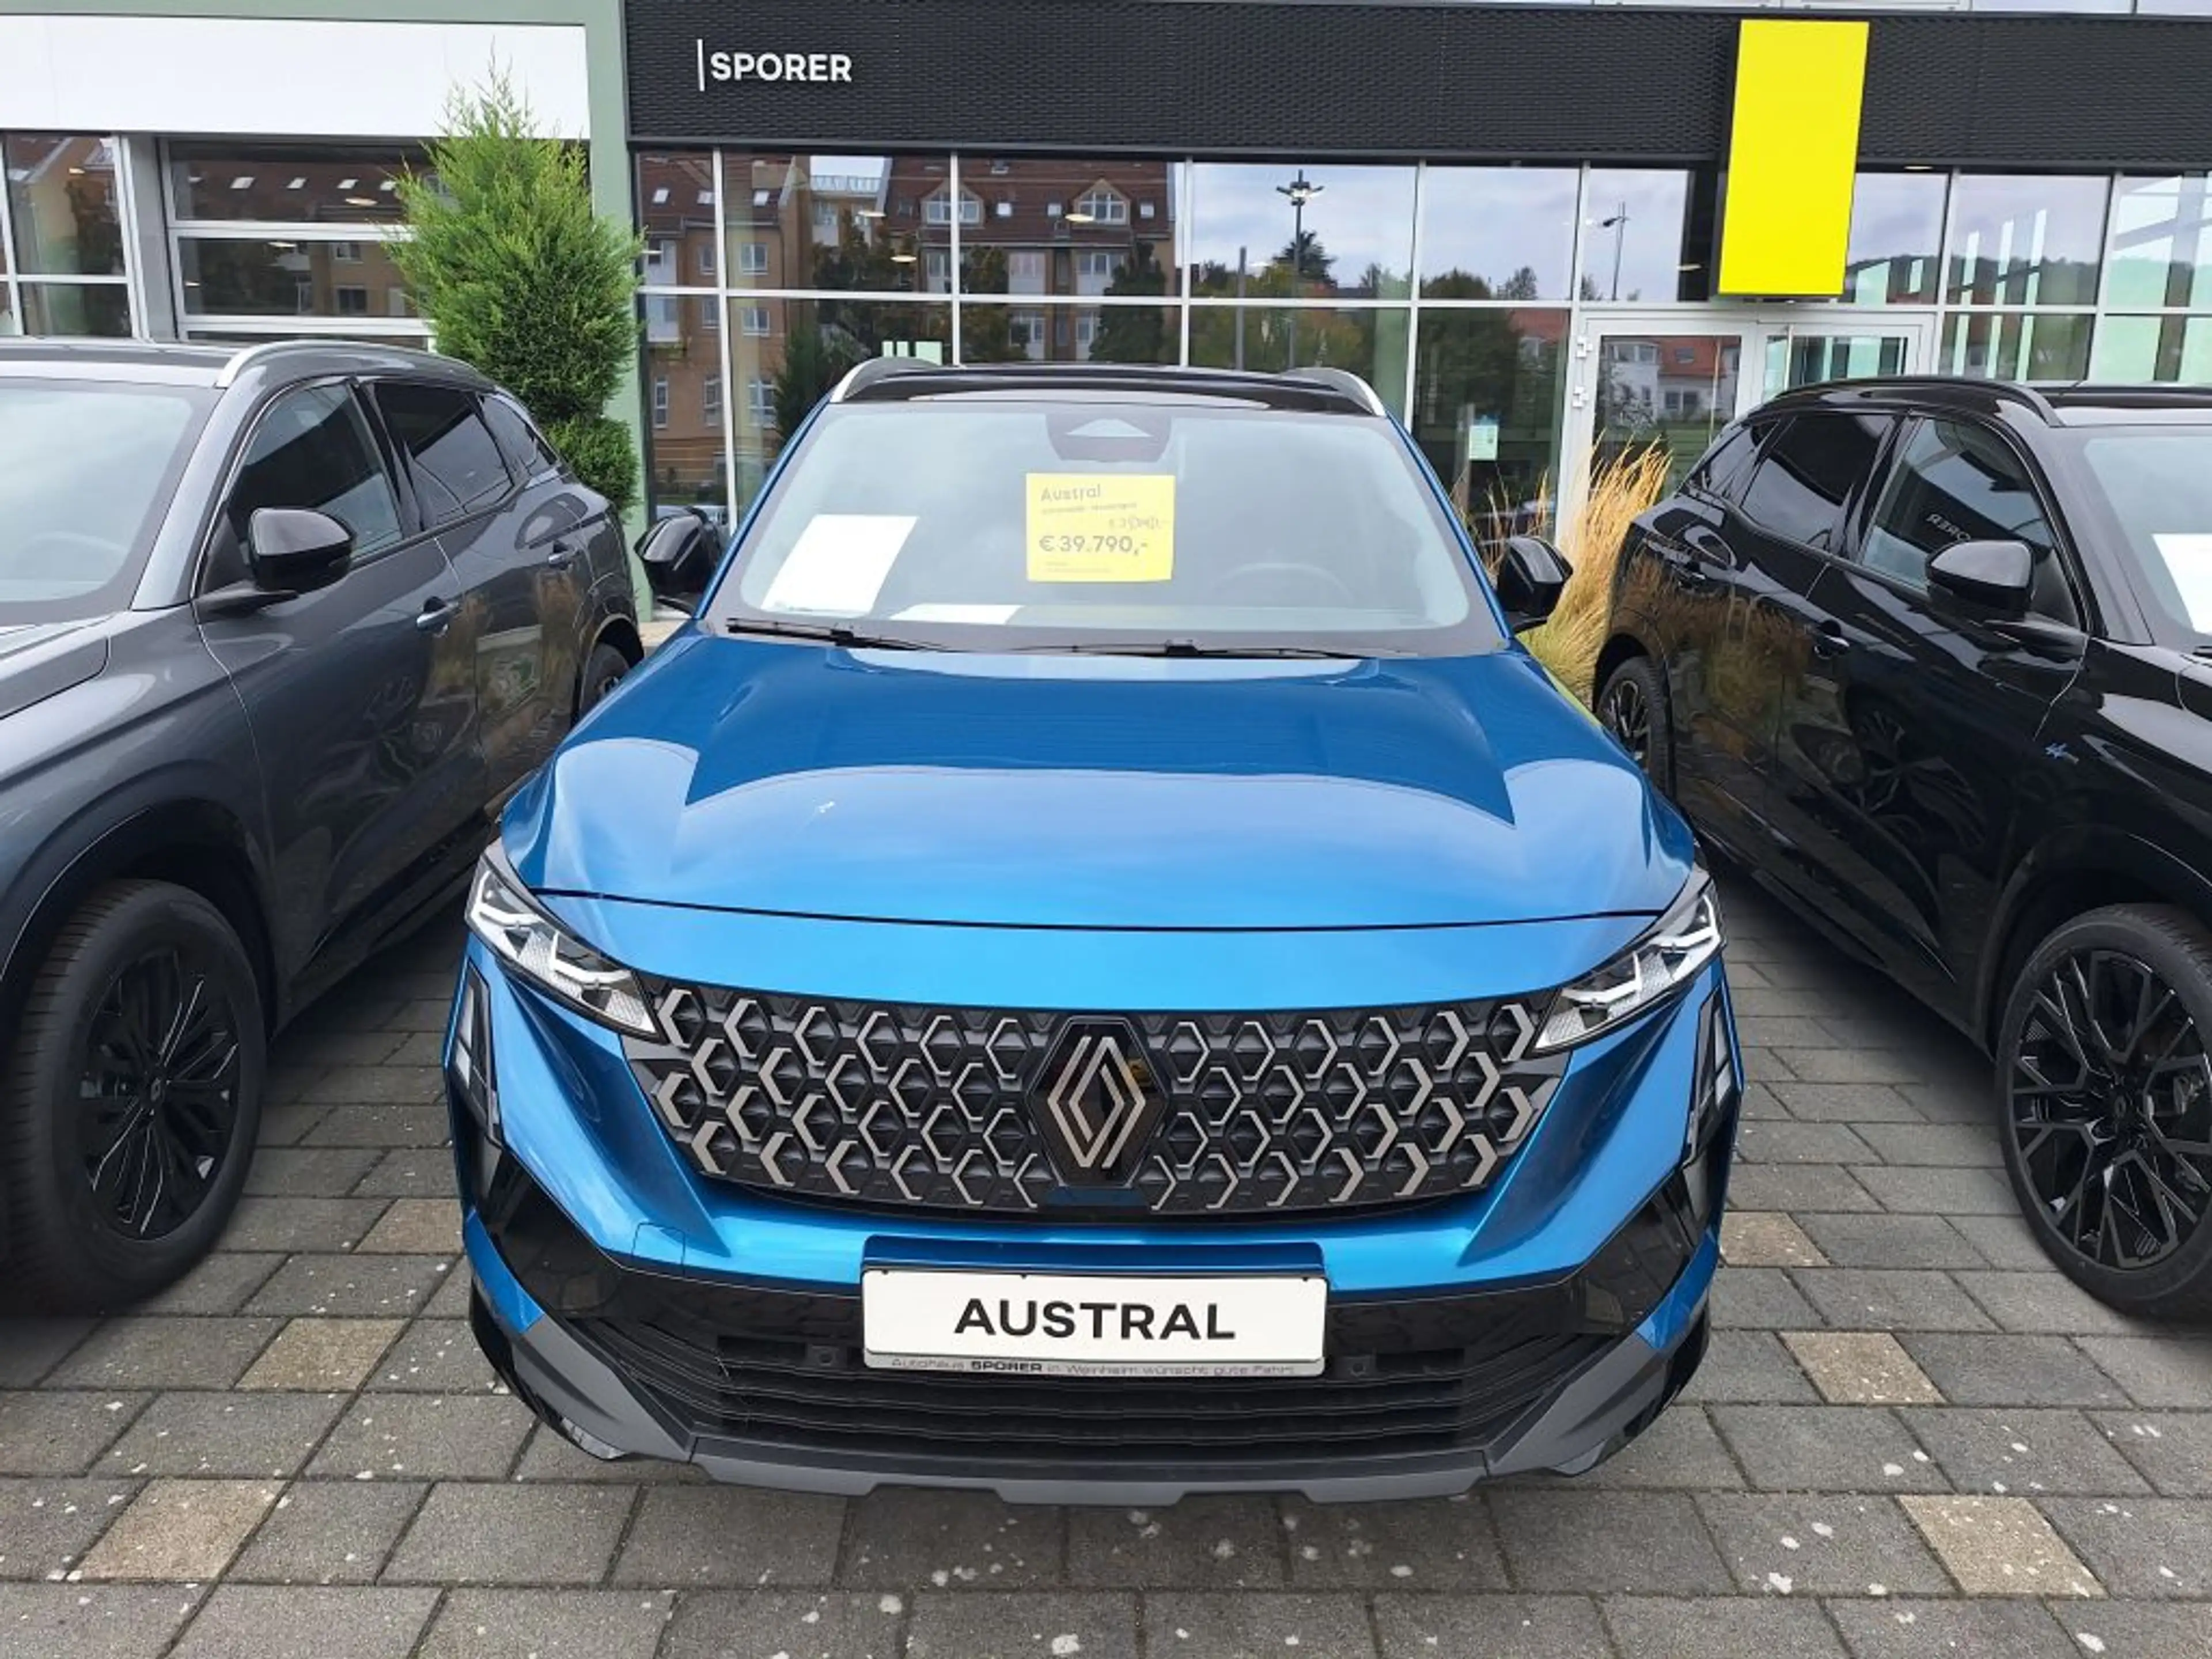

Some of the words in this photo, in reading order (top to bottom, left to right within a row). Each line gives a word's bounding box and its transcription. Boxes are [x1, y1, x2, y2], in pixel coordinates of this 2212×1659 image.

[710, 51, 852, 82] SPORER
[1040, 484, 1101, 501] Austral
[954, 1297, 1236, 1341] AUSTRAL
[970, 1360, 1043, 1372] SPORER
